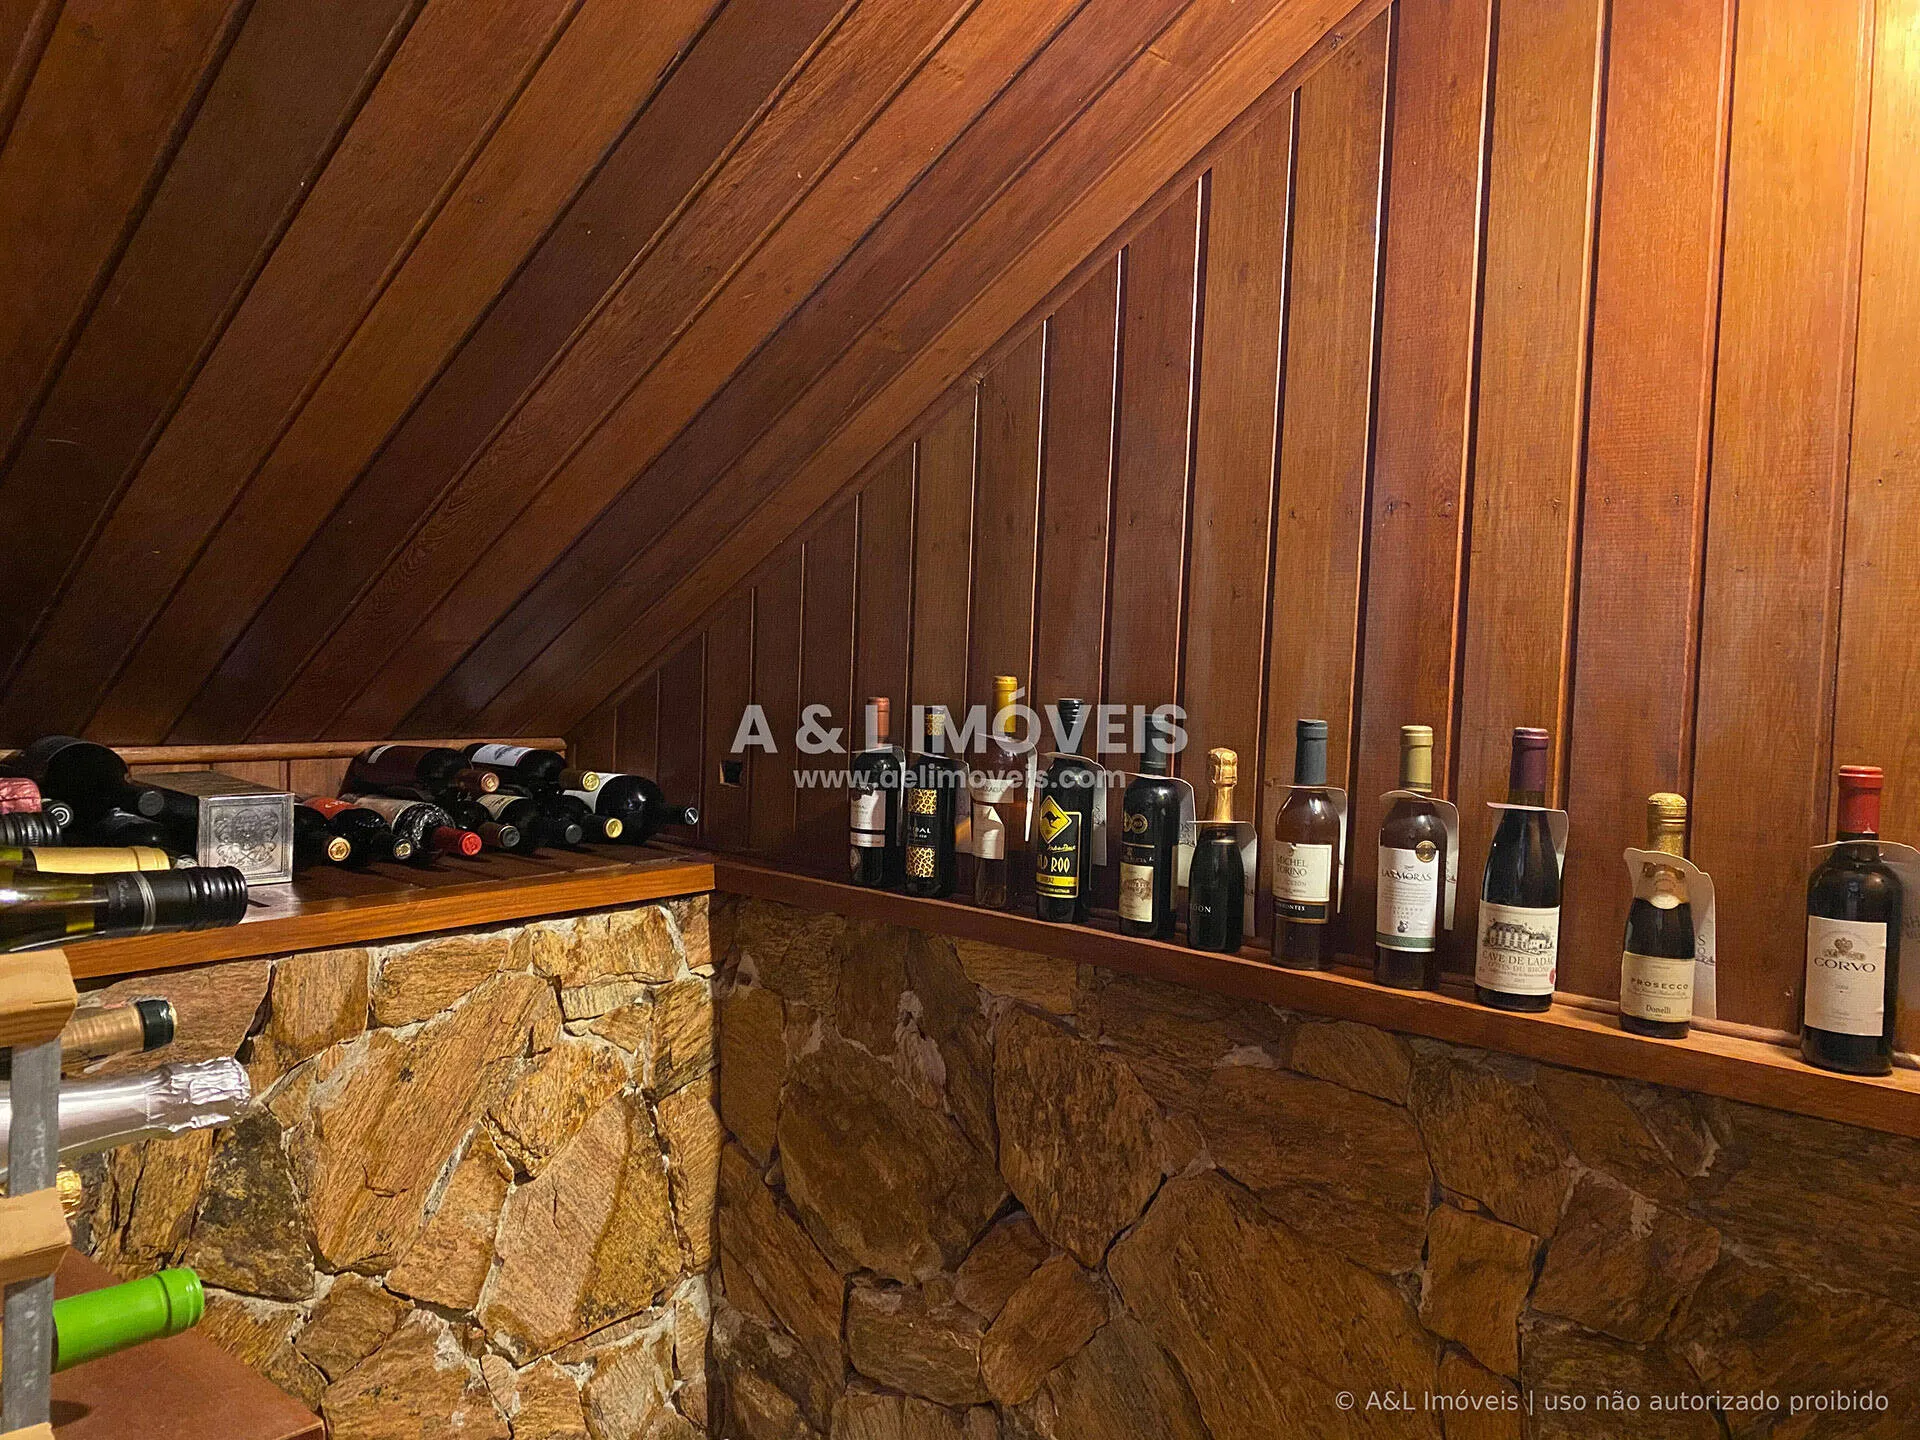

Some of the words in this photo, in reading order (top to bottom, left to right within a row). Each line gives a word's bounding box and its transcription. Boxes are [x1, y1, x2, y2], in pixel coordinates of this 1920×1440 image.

[1509, 955, 1524, 965] DE
[1814, 957, 1876, 973] CORVO
[1630, 976, 1689, 990] PROSECCO
[1646, 1004, 1671, 1015] Donelli
